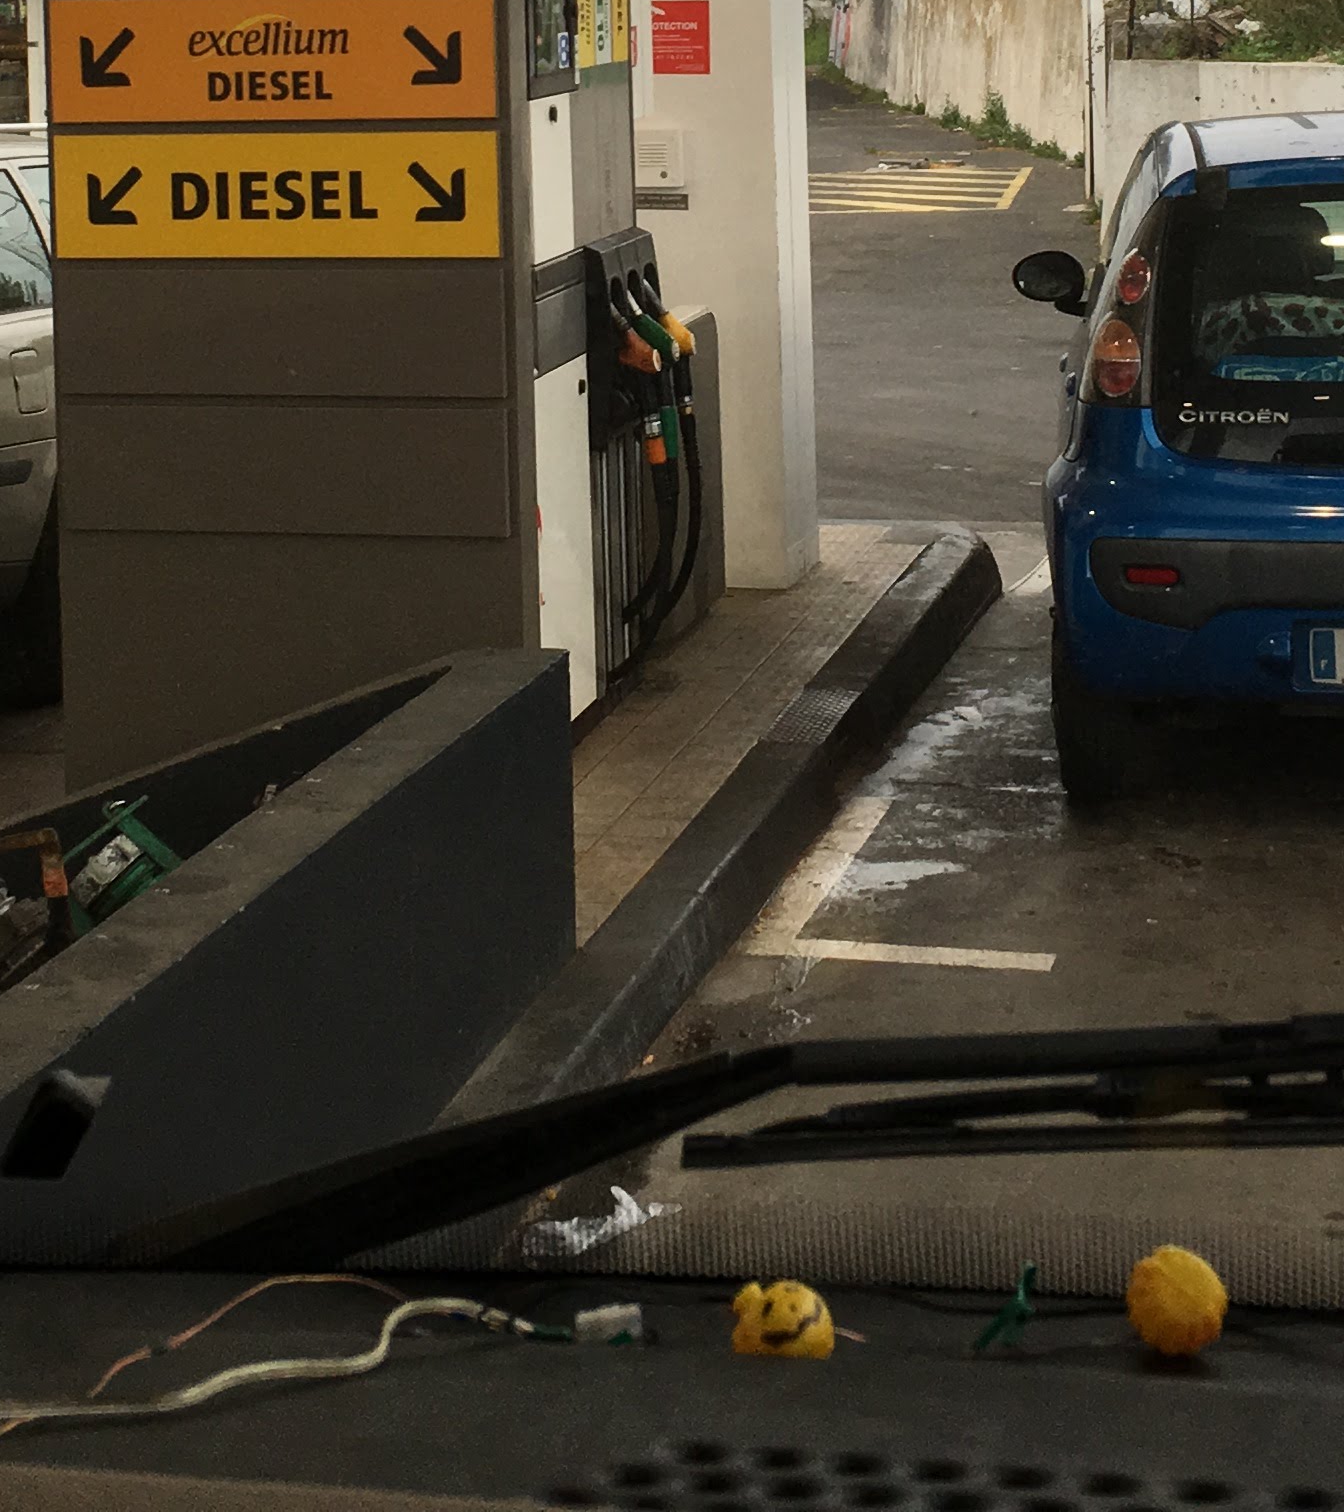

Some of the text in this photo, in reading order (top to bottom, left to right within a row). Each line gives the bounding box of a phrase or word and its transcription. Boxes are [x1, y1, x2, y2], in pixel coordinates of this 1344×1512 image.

[188, 21, 350, 57] excellium
[652, 22, 698, 31] OTECTION
[207, 70, 333, 102] DIESEL
[171, 170, 378, 221] DIESEL
[1178, 408, 1289, 424] CITROËN
